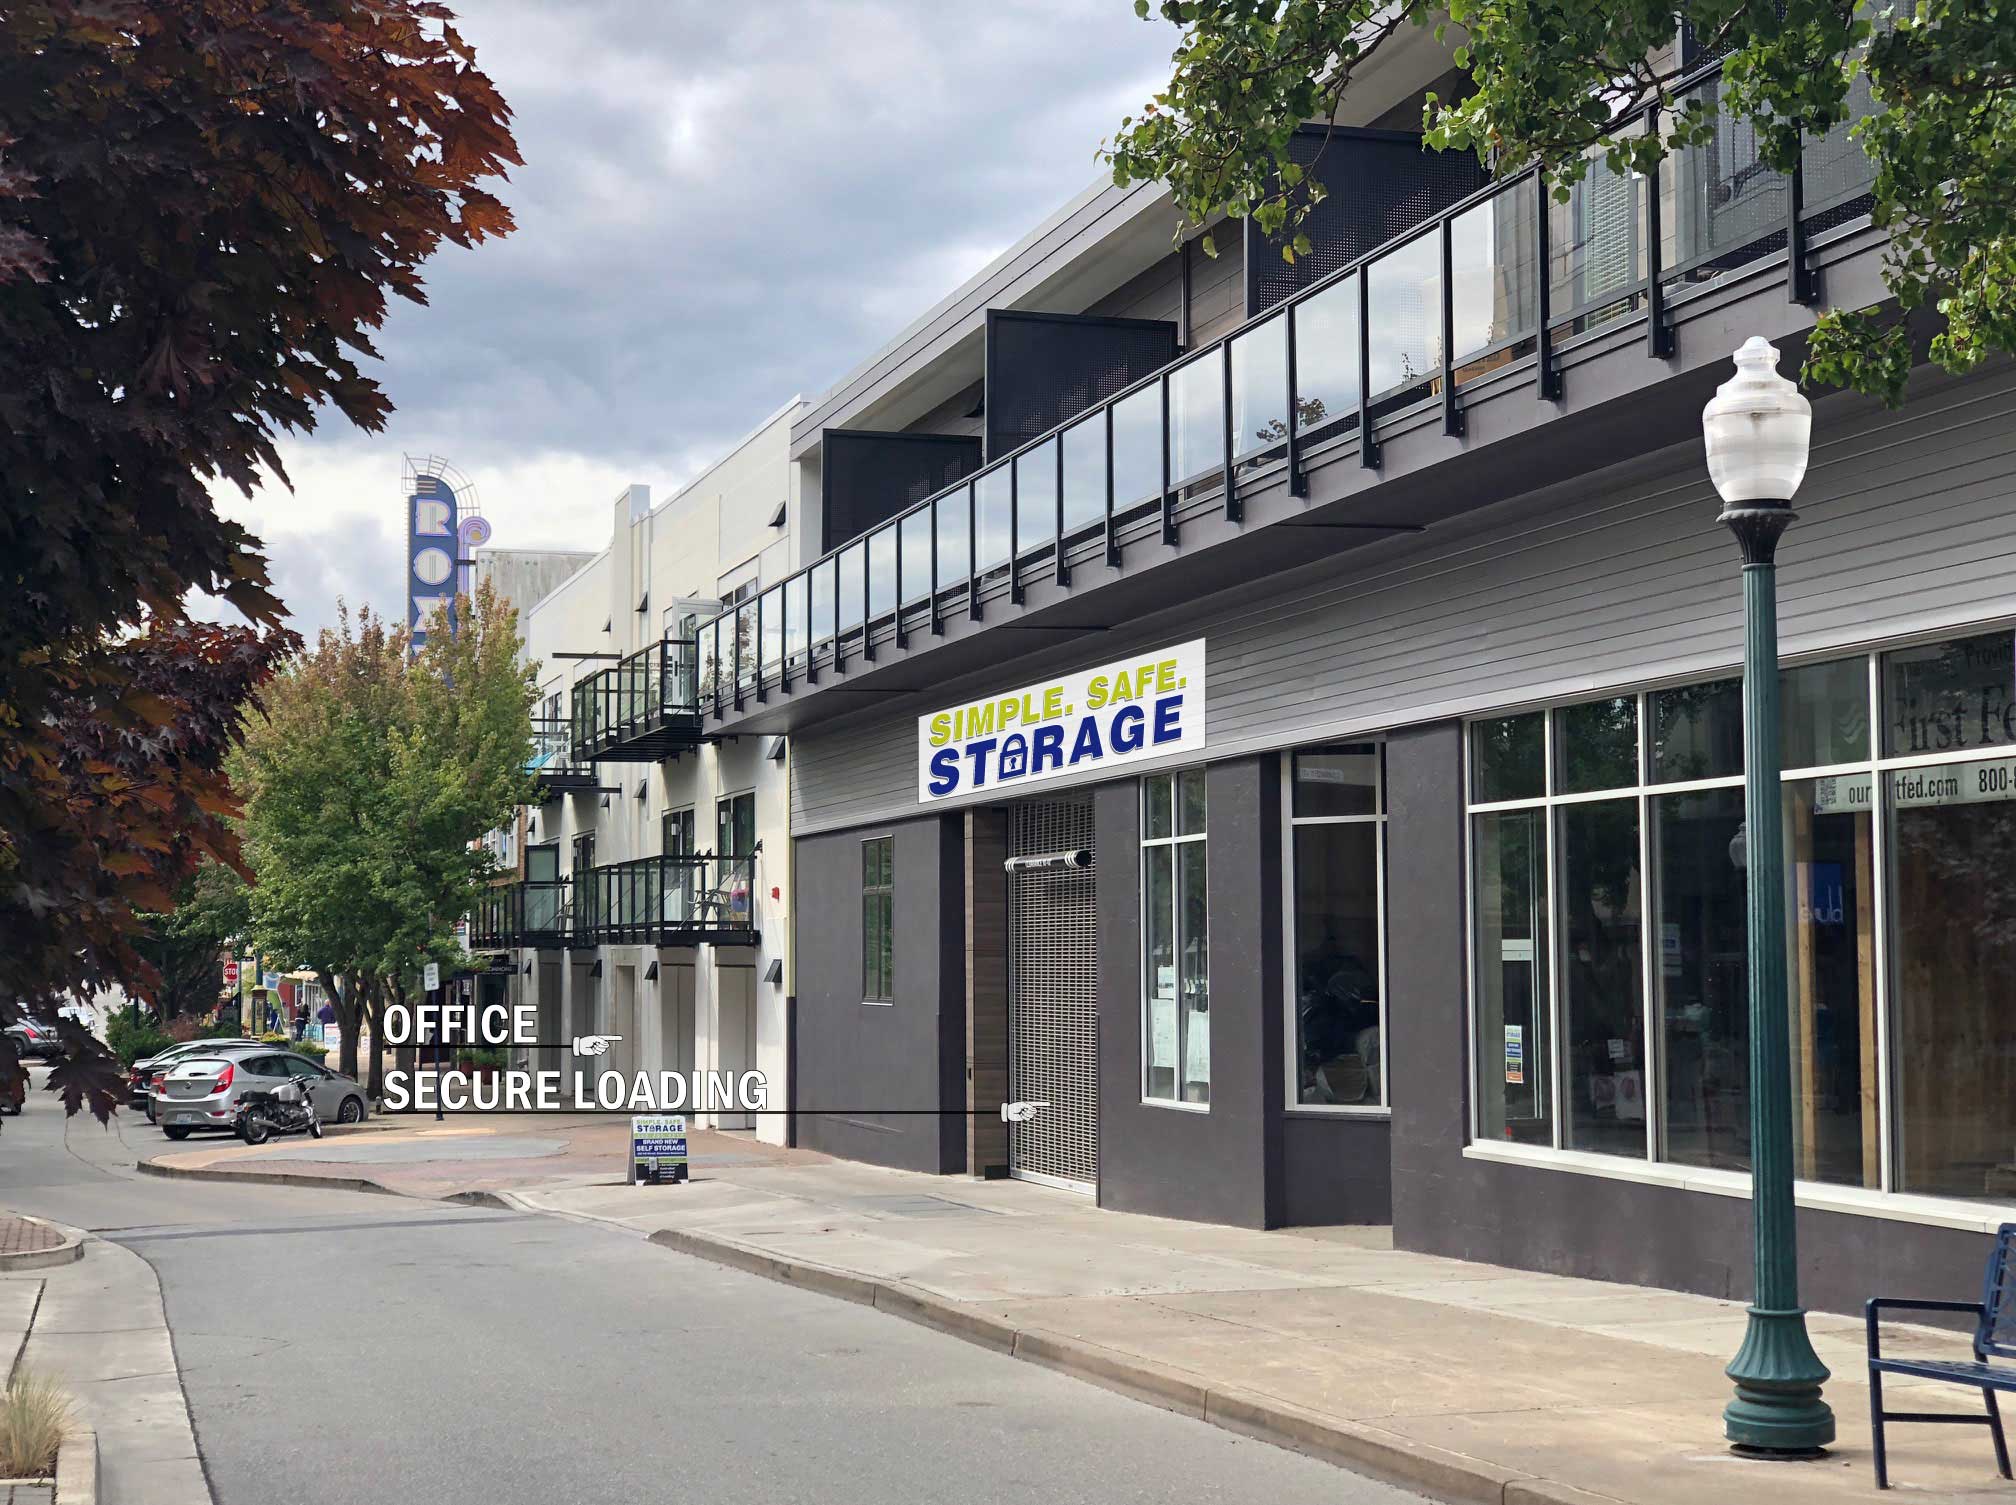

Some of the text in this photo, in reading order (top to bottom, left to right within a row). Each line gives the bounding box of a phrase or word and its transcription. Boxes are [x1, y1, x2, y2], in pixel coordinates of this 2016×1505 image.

[412, 499, 453, 655] ROX
[928, 658, 1188, 747] SIMPLE. SAFE.
[224, 968, 238, 976] STO
